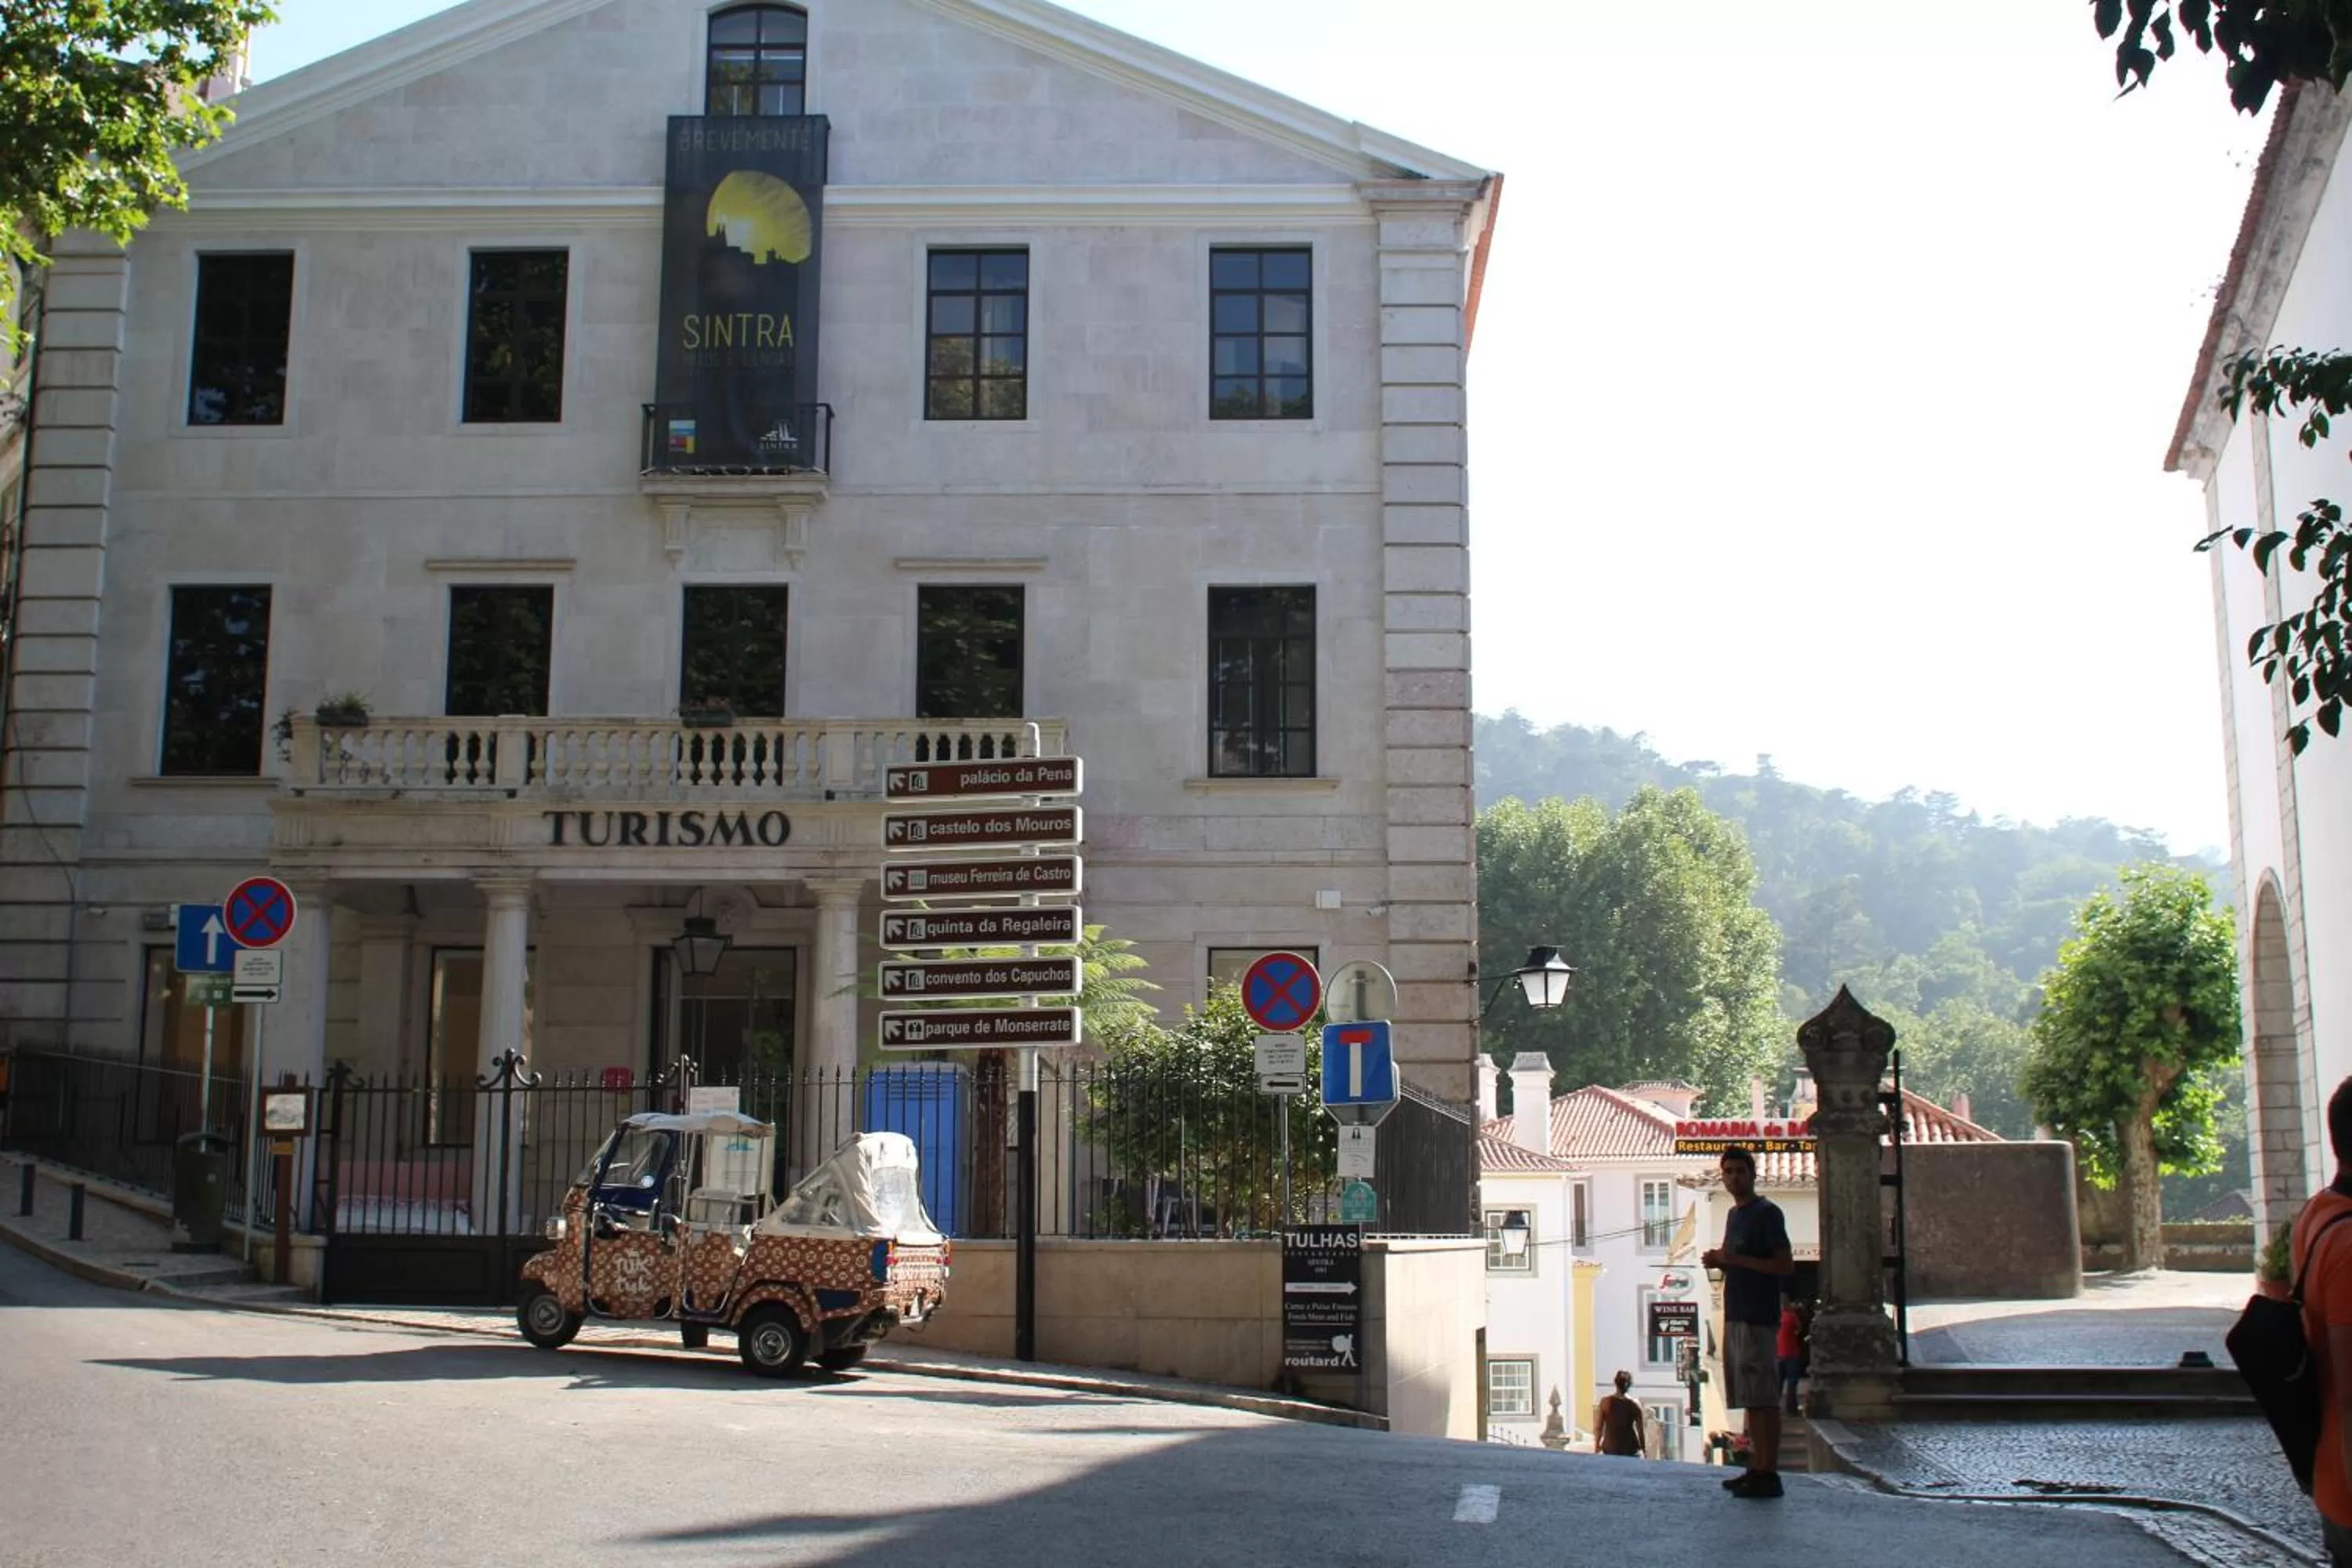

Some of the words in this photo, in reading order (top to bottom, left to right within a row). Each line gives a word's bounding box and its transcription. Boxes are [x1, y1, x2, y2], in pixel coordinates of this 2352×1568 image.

[683, 314, 794, 350] SINTRA
[960, 768, 1011, 787] palácio
[1015, 768, 1033, 782] da
[1037, 766, 1073, 782] Pena
[543, 811, 791, 847] TURISMO
[929, 818, 980, 835] castelo
[985, 818, 1011, 833] dos
[1015, 815, 1072, 832] Mouros
[930, 871, 967, 885] museu
[970, 868, 1013, 884] Ferreira
[1015, 867, 1029, 880] de
[1033, 865, 1071, 880] Castro
[927, 920, 973, 939] quinta
[979, 918, 997, 932] da
[1002, 916, 1071, 936] Regaleira
[926, 968, 981, 985] convento
[985, 968, 1007, 983] dos
[1011, 966, 1071, 985] Capuchos
[926, 1019, 970, 1036] parque
[975, 1018, 990, 1033] de
[995, 1016, 1070, 1033] Monserrate
[1676, 1121, 1759, 1137] ROMARIA
[1764, 1122, 1783, 1136] de
[1765, 1141, 1788, 1152] Bar
[1285, 1232, 1357, 1247] TULHAS
[1285, 1356, 1339, 1367] routard
